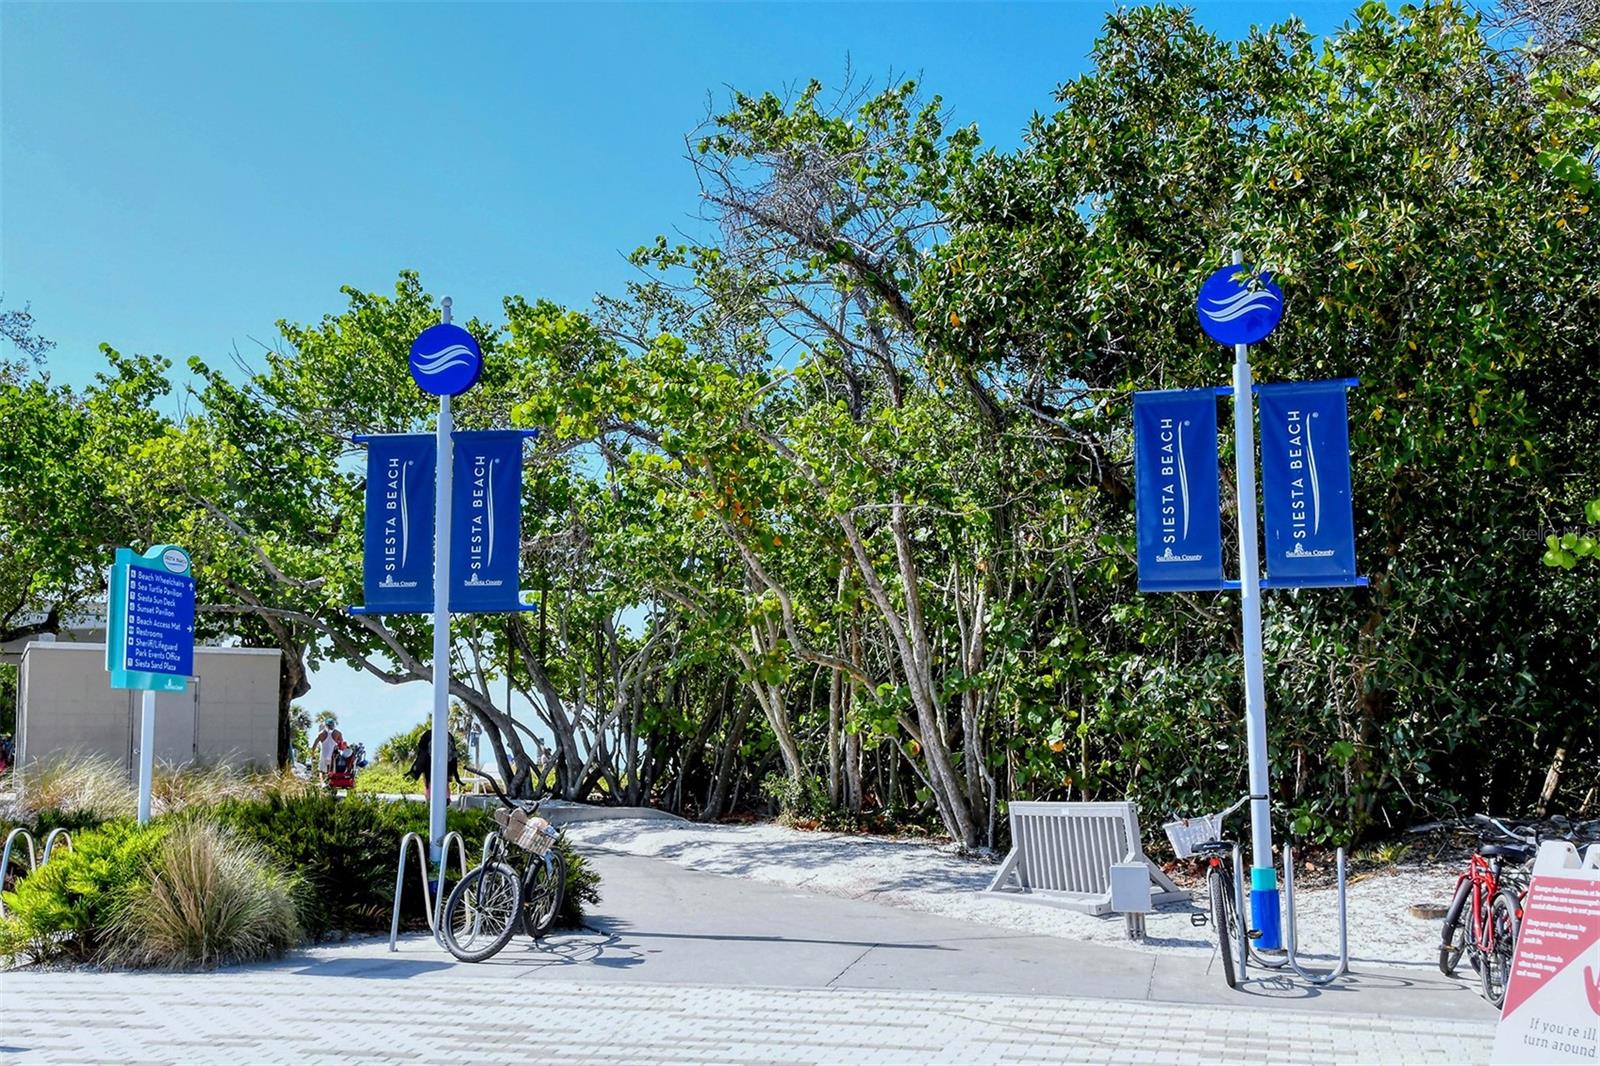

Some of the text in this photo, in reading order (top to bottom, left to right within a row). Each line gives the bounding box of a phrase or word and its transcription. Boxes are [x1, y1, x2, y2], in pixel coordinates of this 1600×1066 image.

[1160, 418, 1176, 543] SIESTA BEACH
[1288, 410, 1306, 538] SIESTA BEACH
[385, 458, 399, 571] SIESTA BEACH
[471, 456, 485, 570] SIESTA BEACH
[1286, 550, 1312, 558] Sarota
[138, 571, 184, 588] Beach Wheelchairs
[138, 582, 182, 598] Sea Turtle Pavilion
[137, 593, 176, 607] Siesta Sun Deck
[137, 603, 175, 617] Sunset Pavilion
[137, 616, 180, 631] Beach Access Mat
[136, 627, 163, 638] Restrooms
[136, 638, 178, 651] Sheriff/Lifeguard
[136, 648, 180, 661] Park Events Office
[135, 659, 176, 671] Siesta Sand Plaza
[1530, 1017, 1540, 1030] If
[1524, 1034, 1548, 1048] turn
